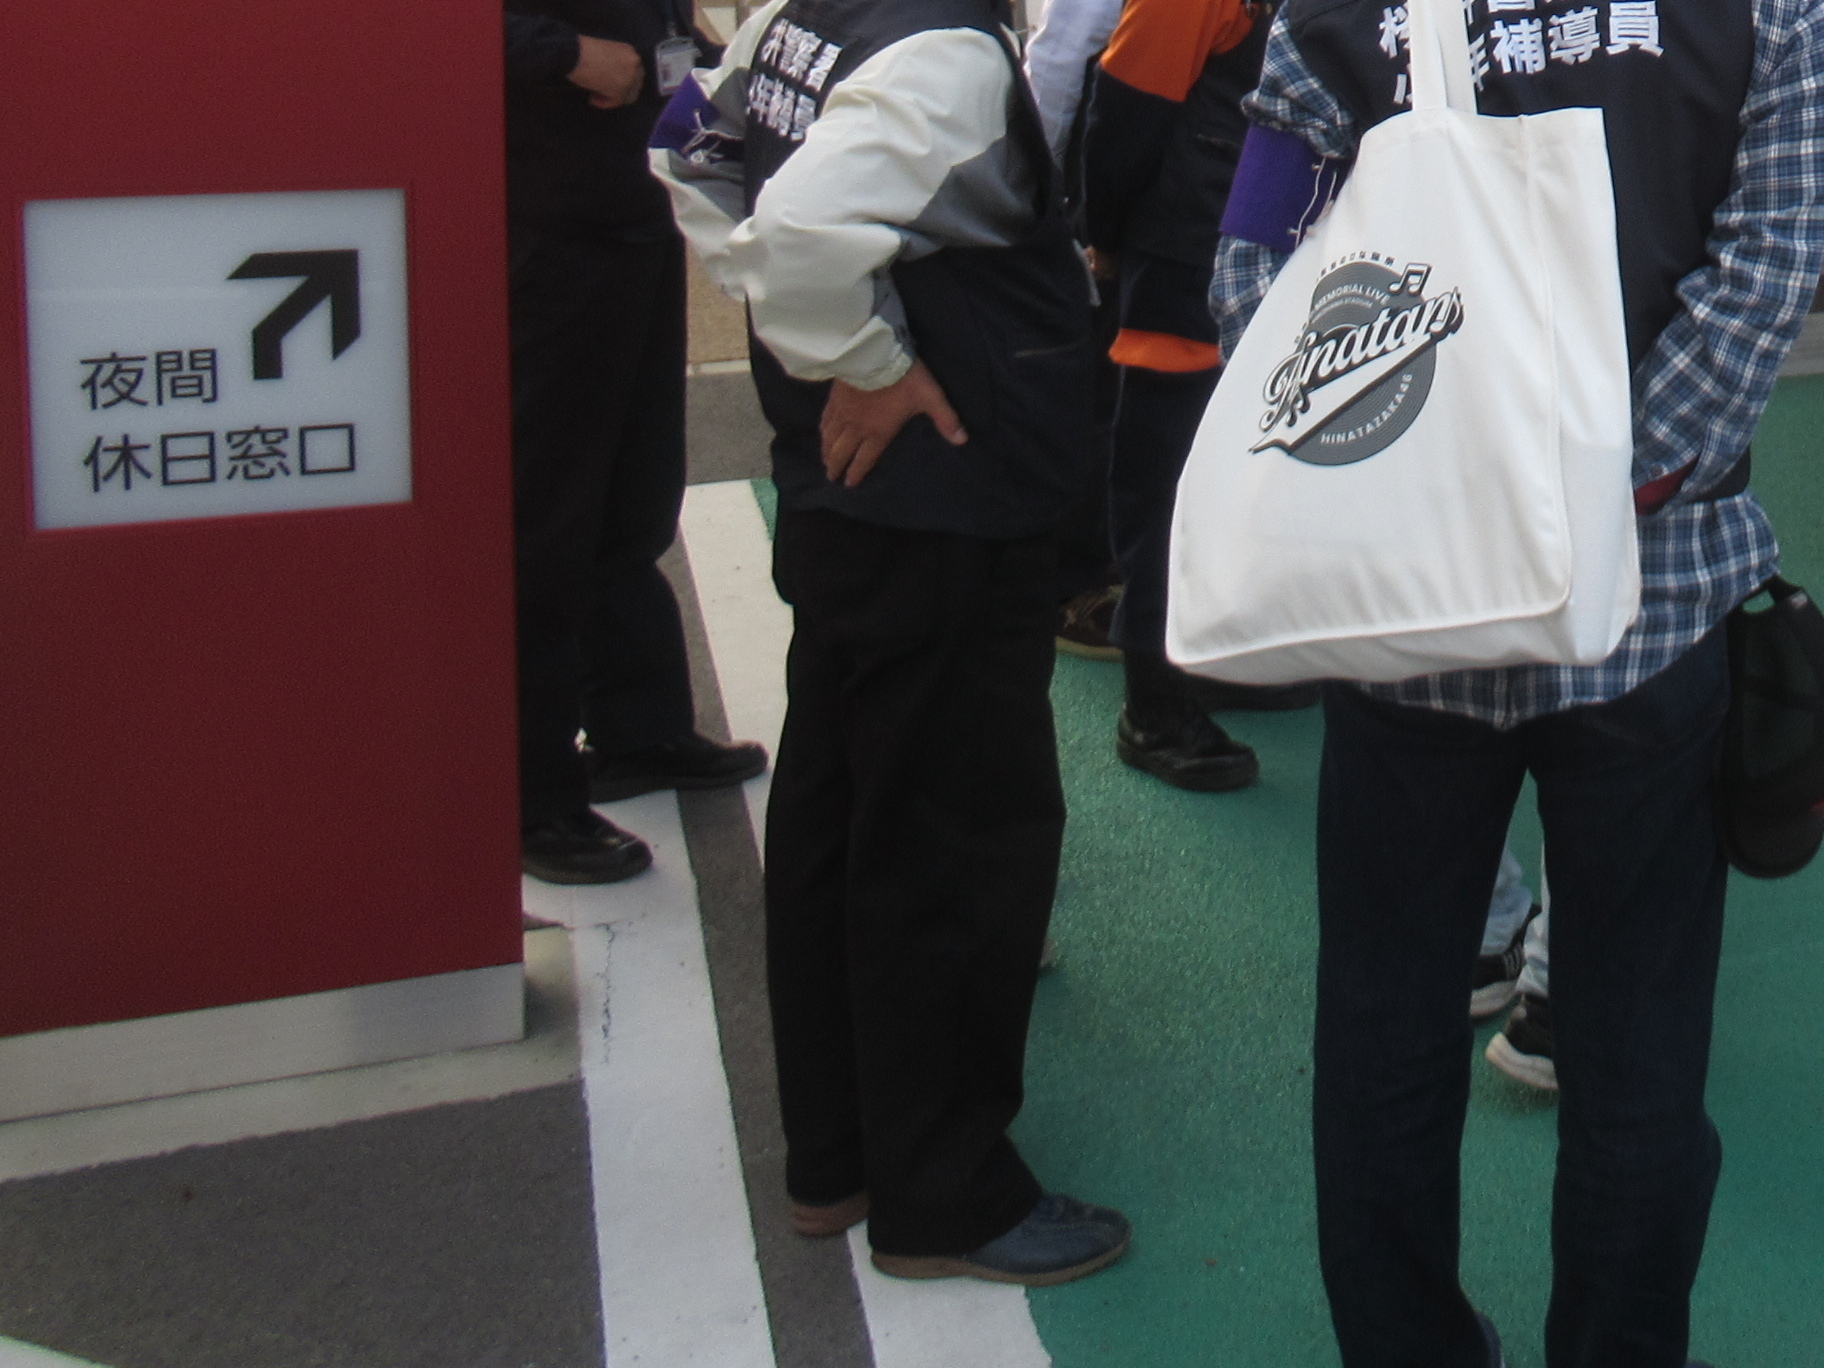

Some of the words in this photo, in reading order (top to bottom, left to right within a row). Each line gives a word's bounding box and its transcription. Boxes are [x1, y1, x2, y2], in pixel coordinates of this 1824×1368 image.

[1393, 0, 1665, 105] 補導員
[80, 348, 219, 411] 夜間
[82, 422, 357, 494] 休日窓口
